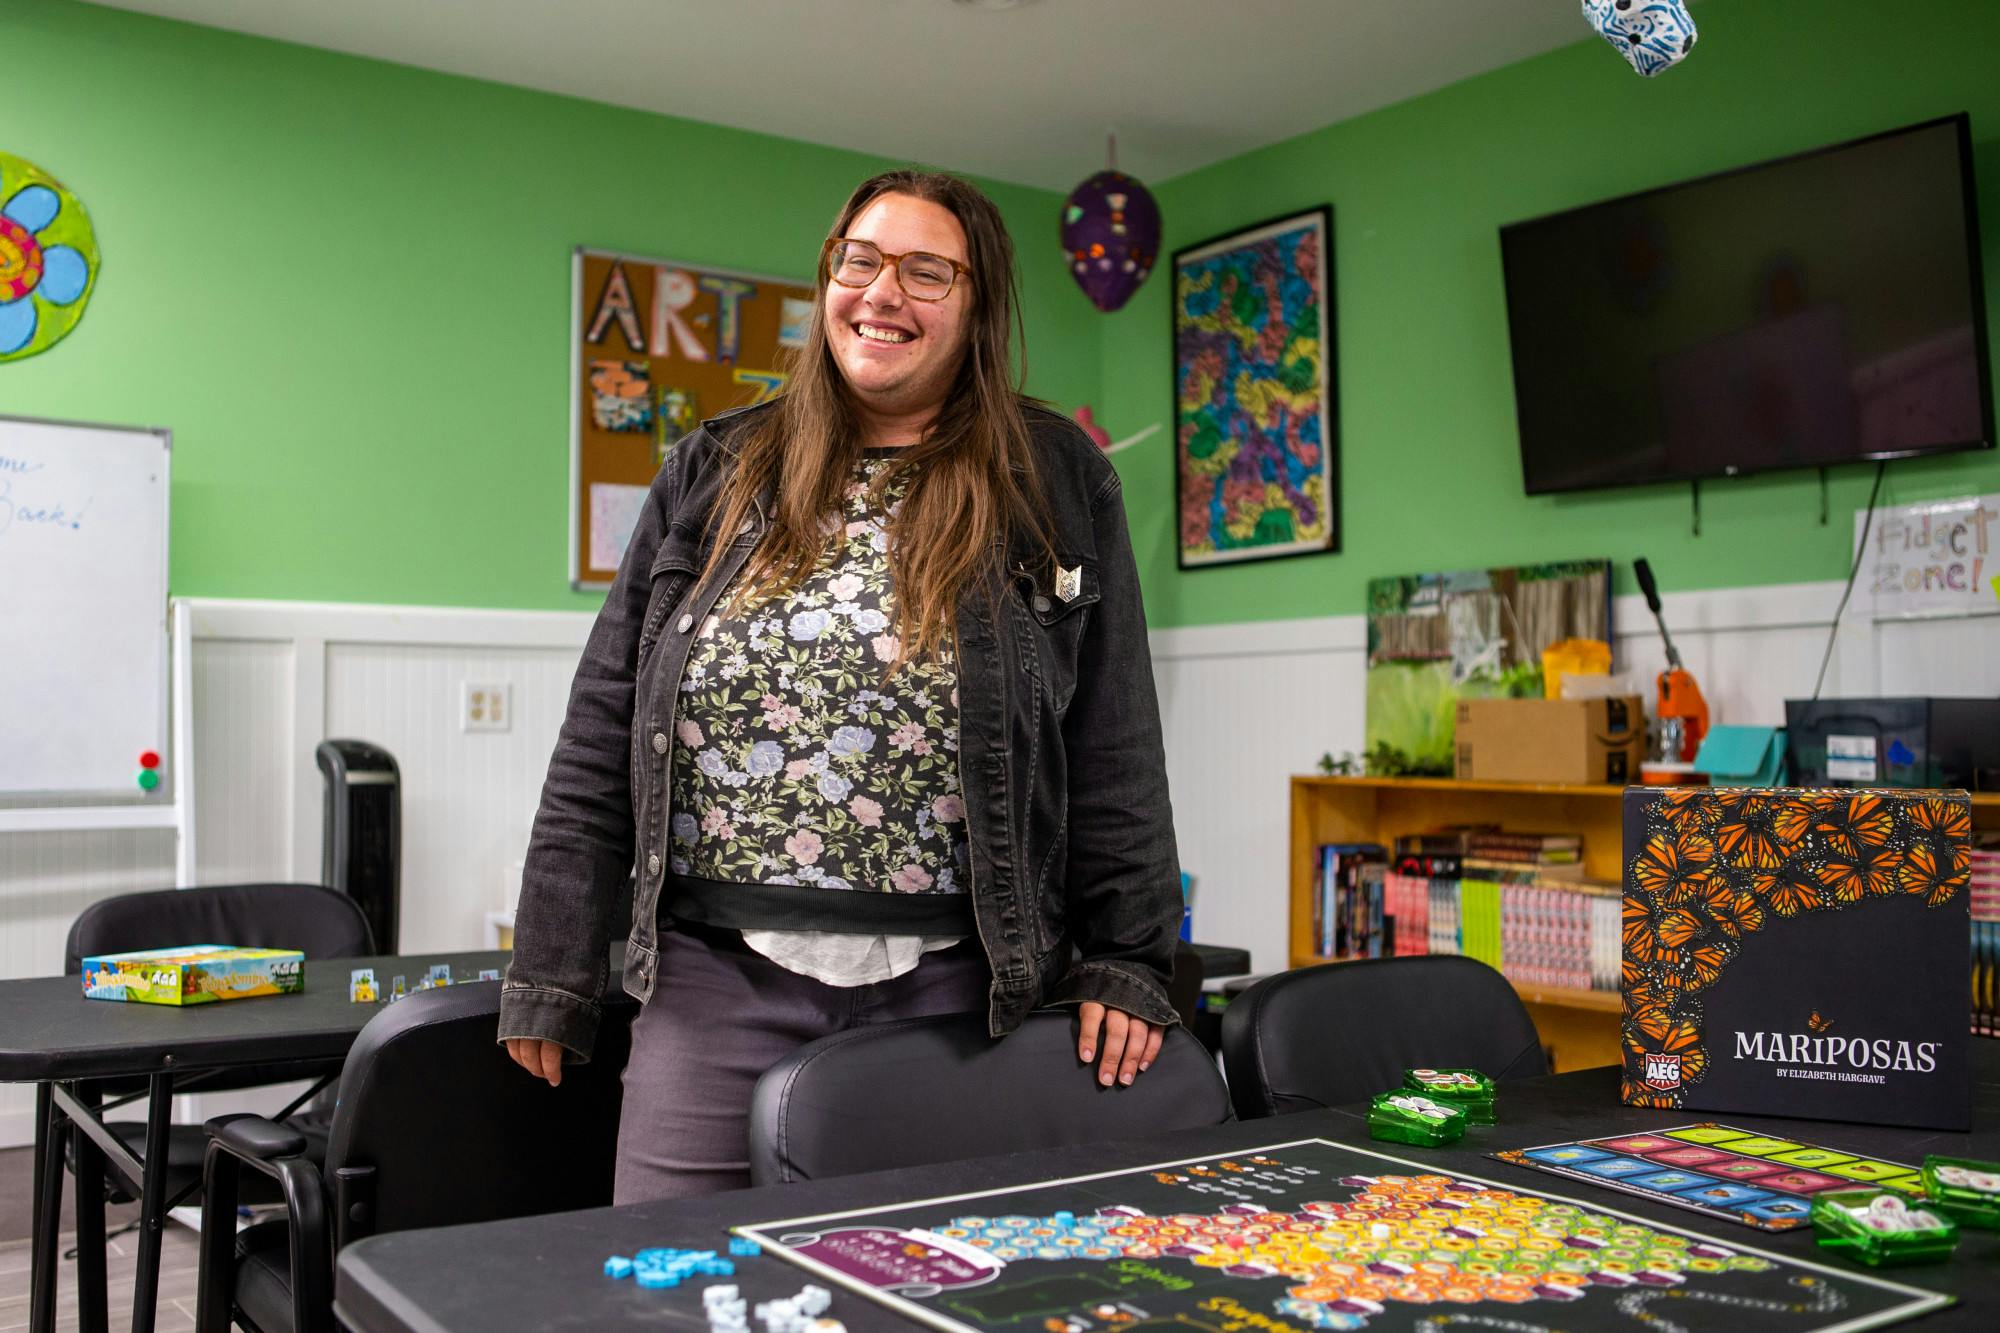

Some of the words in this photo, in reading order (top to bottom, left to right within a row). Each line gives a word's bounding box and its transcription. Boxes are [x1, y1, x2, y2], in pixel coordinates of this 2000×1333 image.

[586, 257, 757, 366] ART
[1646, 1062, 1680, 1081] AEG
[1776, 1068, 1788, 1078] BY
[1789, 1069, 1836, 1081] ELIZABETH
[1838, 1072, 1886, 1084] HARGRAVE
